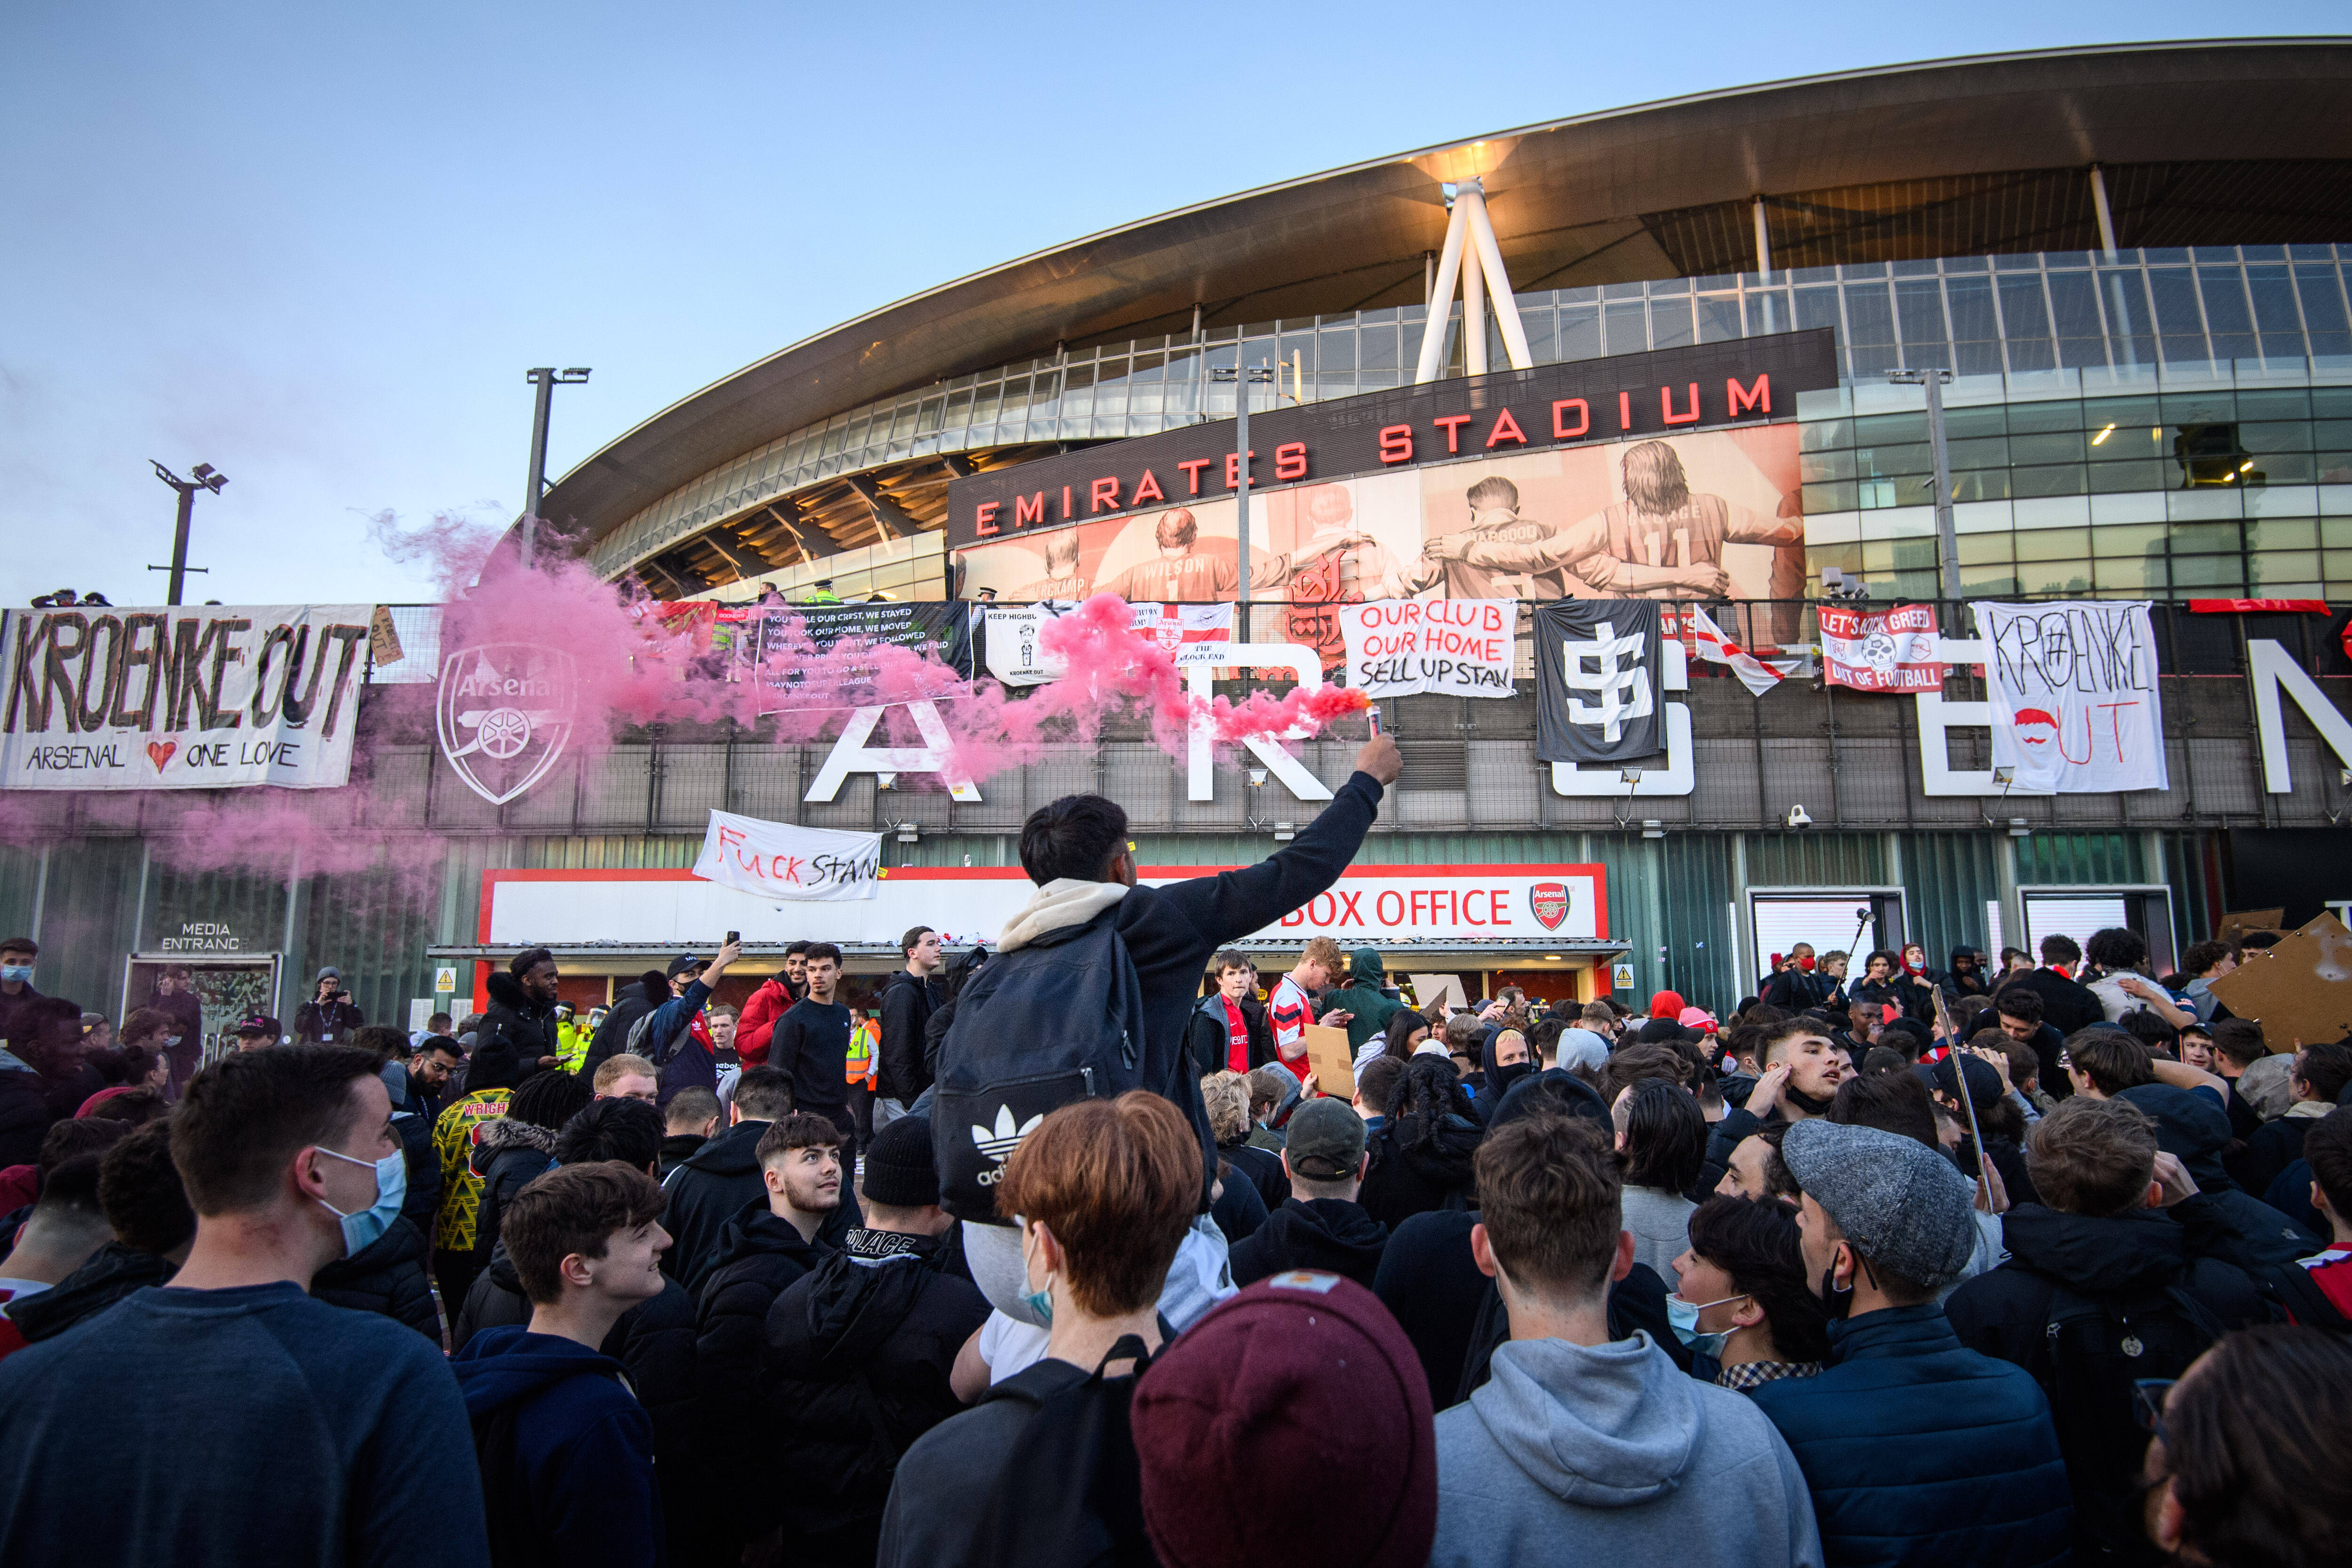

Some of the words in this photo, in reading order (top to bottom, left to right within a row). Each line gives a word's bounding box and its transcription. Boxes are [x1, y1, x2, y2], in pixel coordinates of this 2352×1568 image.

[977, 442, 1306, 536] EMIRATES
[1379, 374, 1771, 462] STADIUM
[1466, 525, 1537, 543] HAPGOOD
[1145, 558, 1204, 579] WILSON
[1032, 579, 1084, 597] ERGKAMP
[837, 612, 864, 622] CREST,
[881, 608, 912, 618] STAYED
[1361, 603, 1420, 628] OUR
[1426, 599, 1502, 632] CLUB
[1822, 613, 1859, 635] LET'S
[1859, 615, 1888, 635] KICK
[1889, 610, 1930, 630] GREED
[879, 632, 925, 644] FOLLOWED
[881, 622, 912, 632] MOVED
[929, 641, 948, 650] PAID
[1364, 631, 1417, 657] OUR
[1425, 628, 1503, 661] HOME
[1990, 605, 2153, 694] KROENKE
[3, 613, 252, 733] KROENKE
[252, 623, 370, 741] OUT
[1359, 659, 1416, 686] SELL
[1422, 658, 1453, 682] UP
[1456, 662, 1509, 688] STAN
[1832, 663, 1853, 684] OUT
[1855, 671, 1872, 686] OF
[1875, 668, 1940, 687] FOOTBALL
[457, 675, 553, 697] Arsena
[26, 745, 125, 769] ARSENAL
[187, 744, 230, 767] ONE
[240, 742, 301, 767] LOVE
[719, 826, 804, 888] FUCK
[807, 854, 877, 886] STAN
[1535, 890, 1565, 898] Arsenal
[1376, 890, 1512, 927] OFFICE
[183, 923, 230, 935] MEDIA
[464, 1102, 509, 1116] WRIGH
